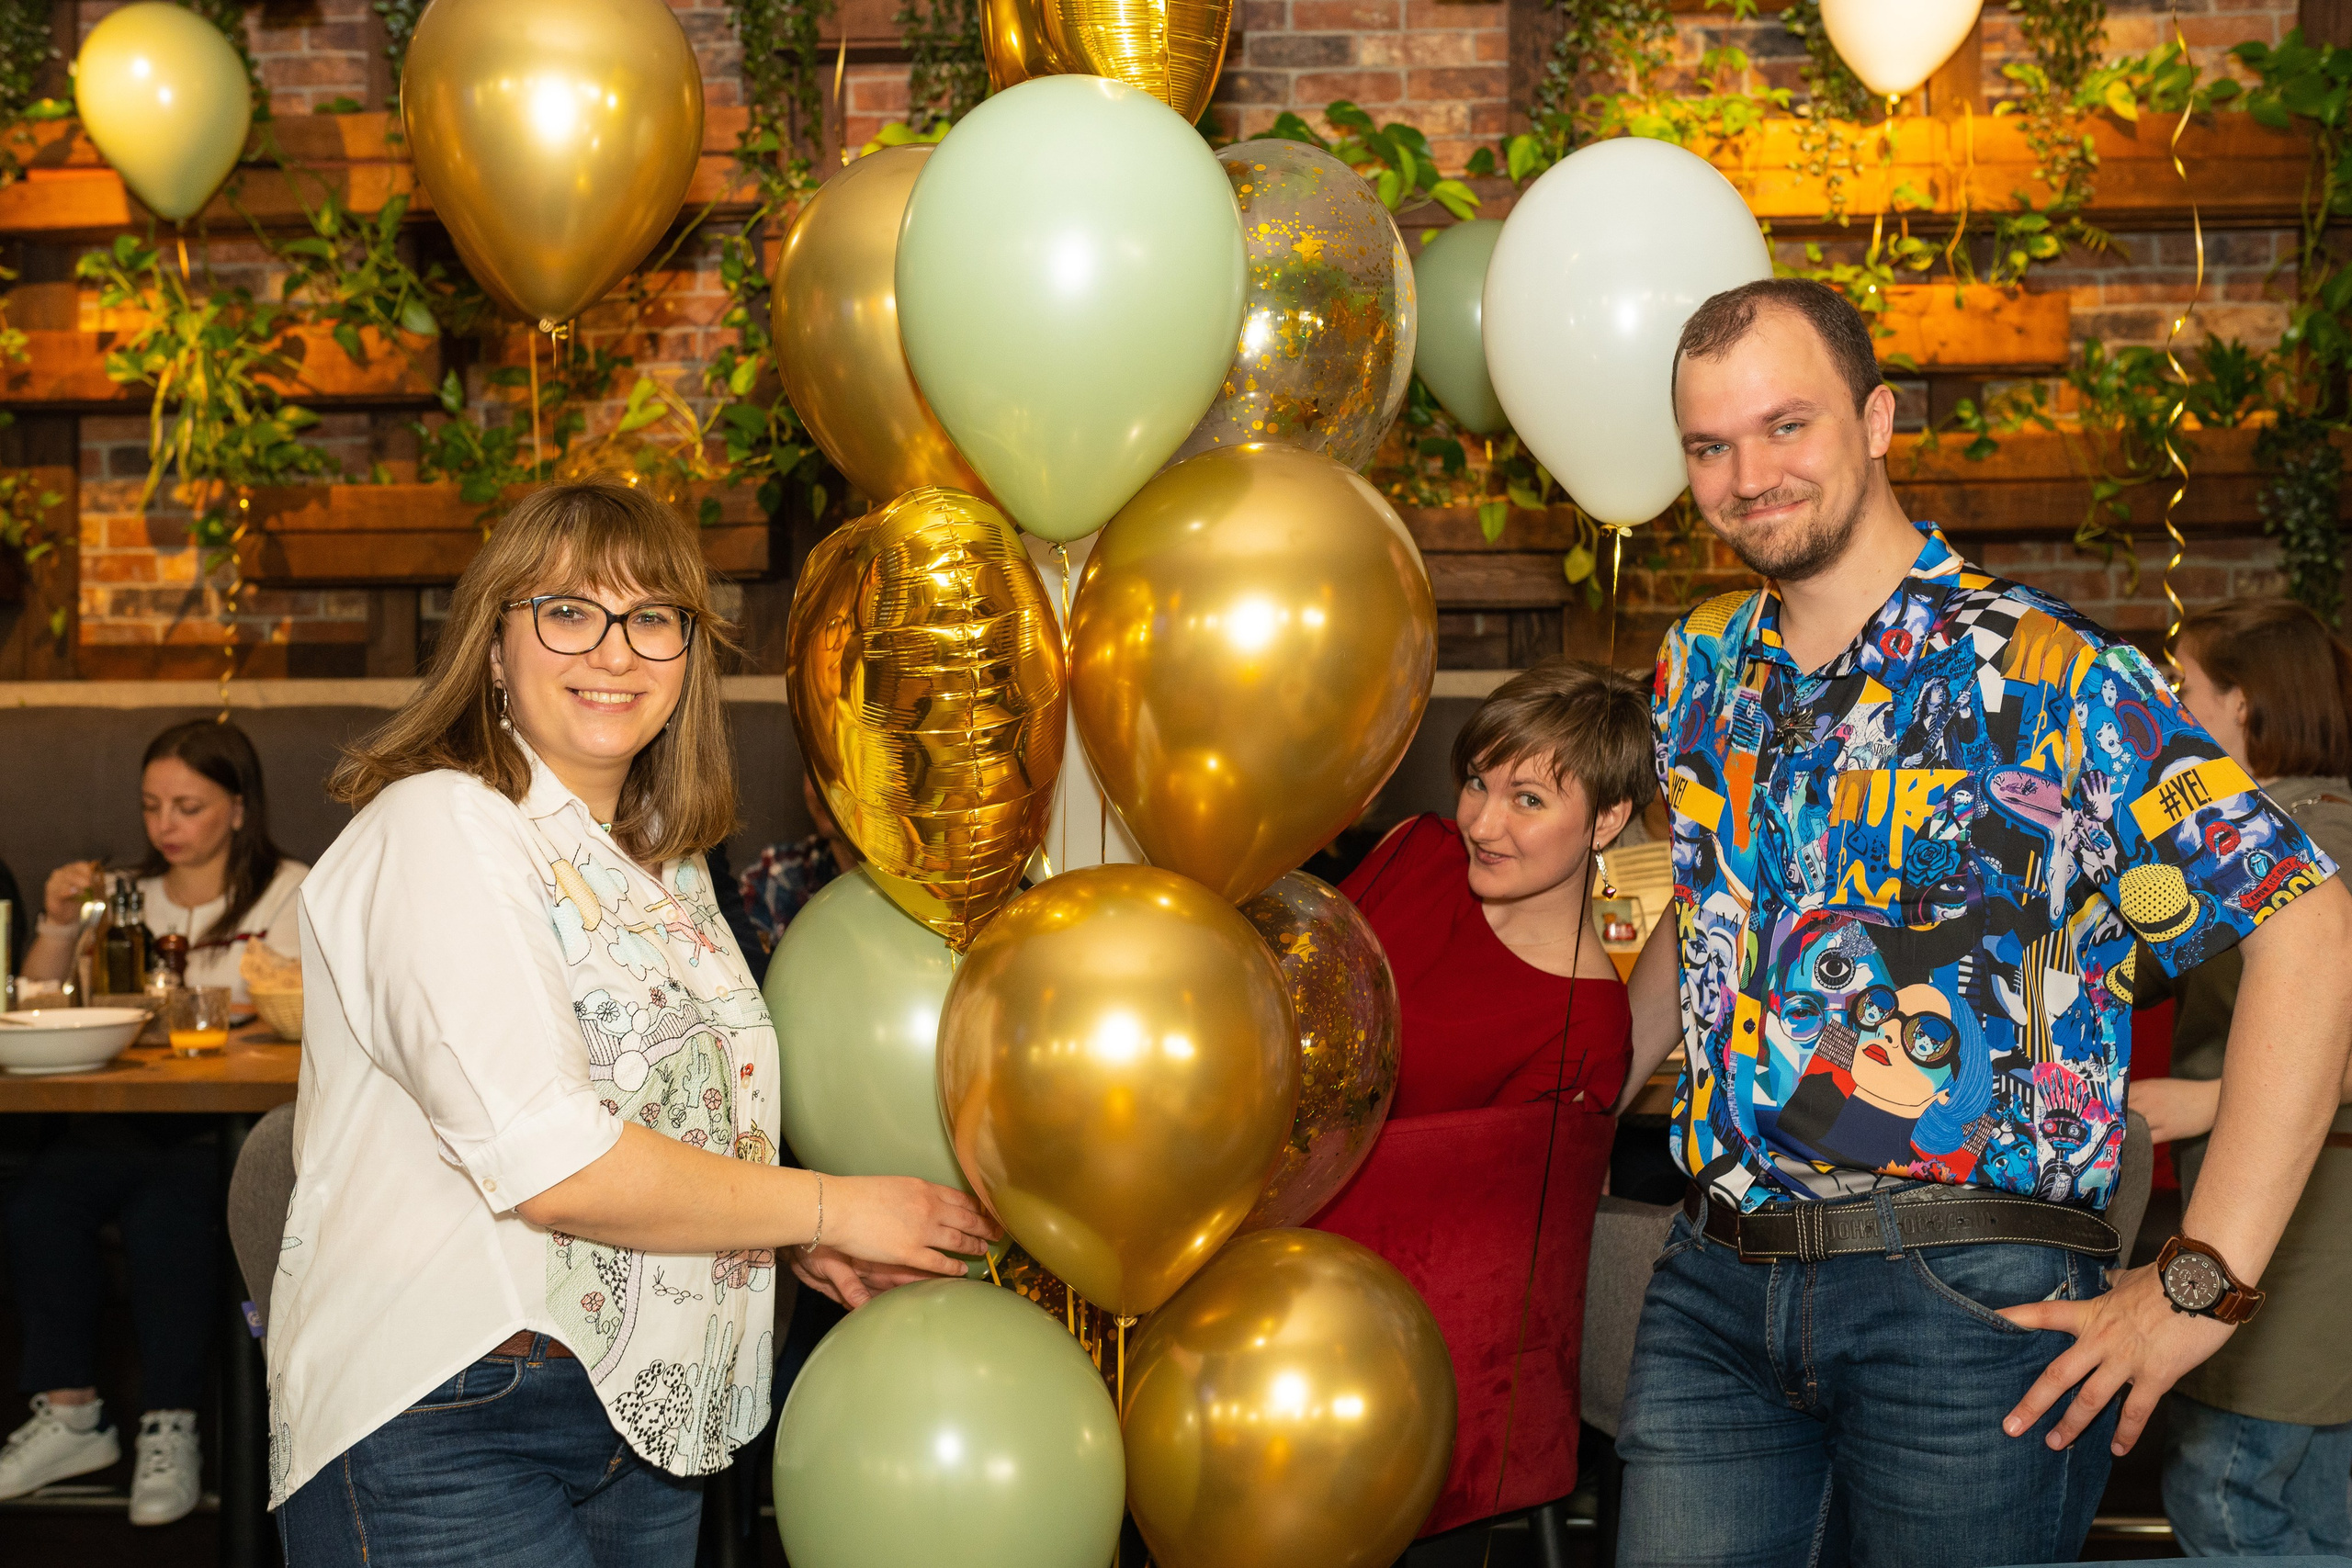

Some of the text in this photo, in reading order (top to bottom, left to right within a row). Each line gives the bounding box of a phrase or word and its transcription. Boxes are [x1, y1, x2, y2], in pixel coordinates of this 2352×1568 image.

[1671, 774, 1689, 810] YE!
[1992, 775, 2005, 788] 12
[2158, 768, 2212, 822] #YE!
[2278, 861, 2294, 876] ONLY
